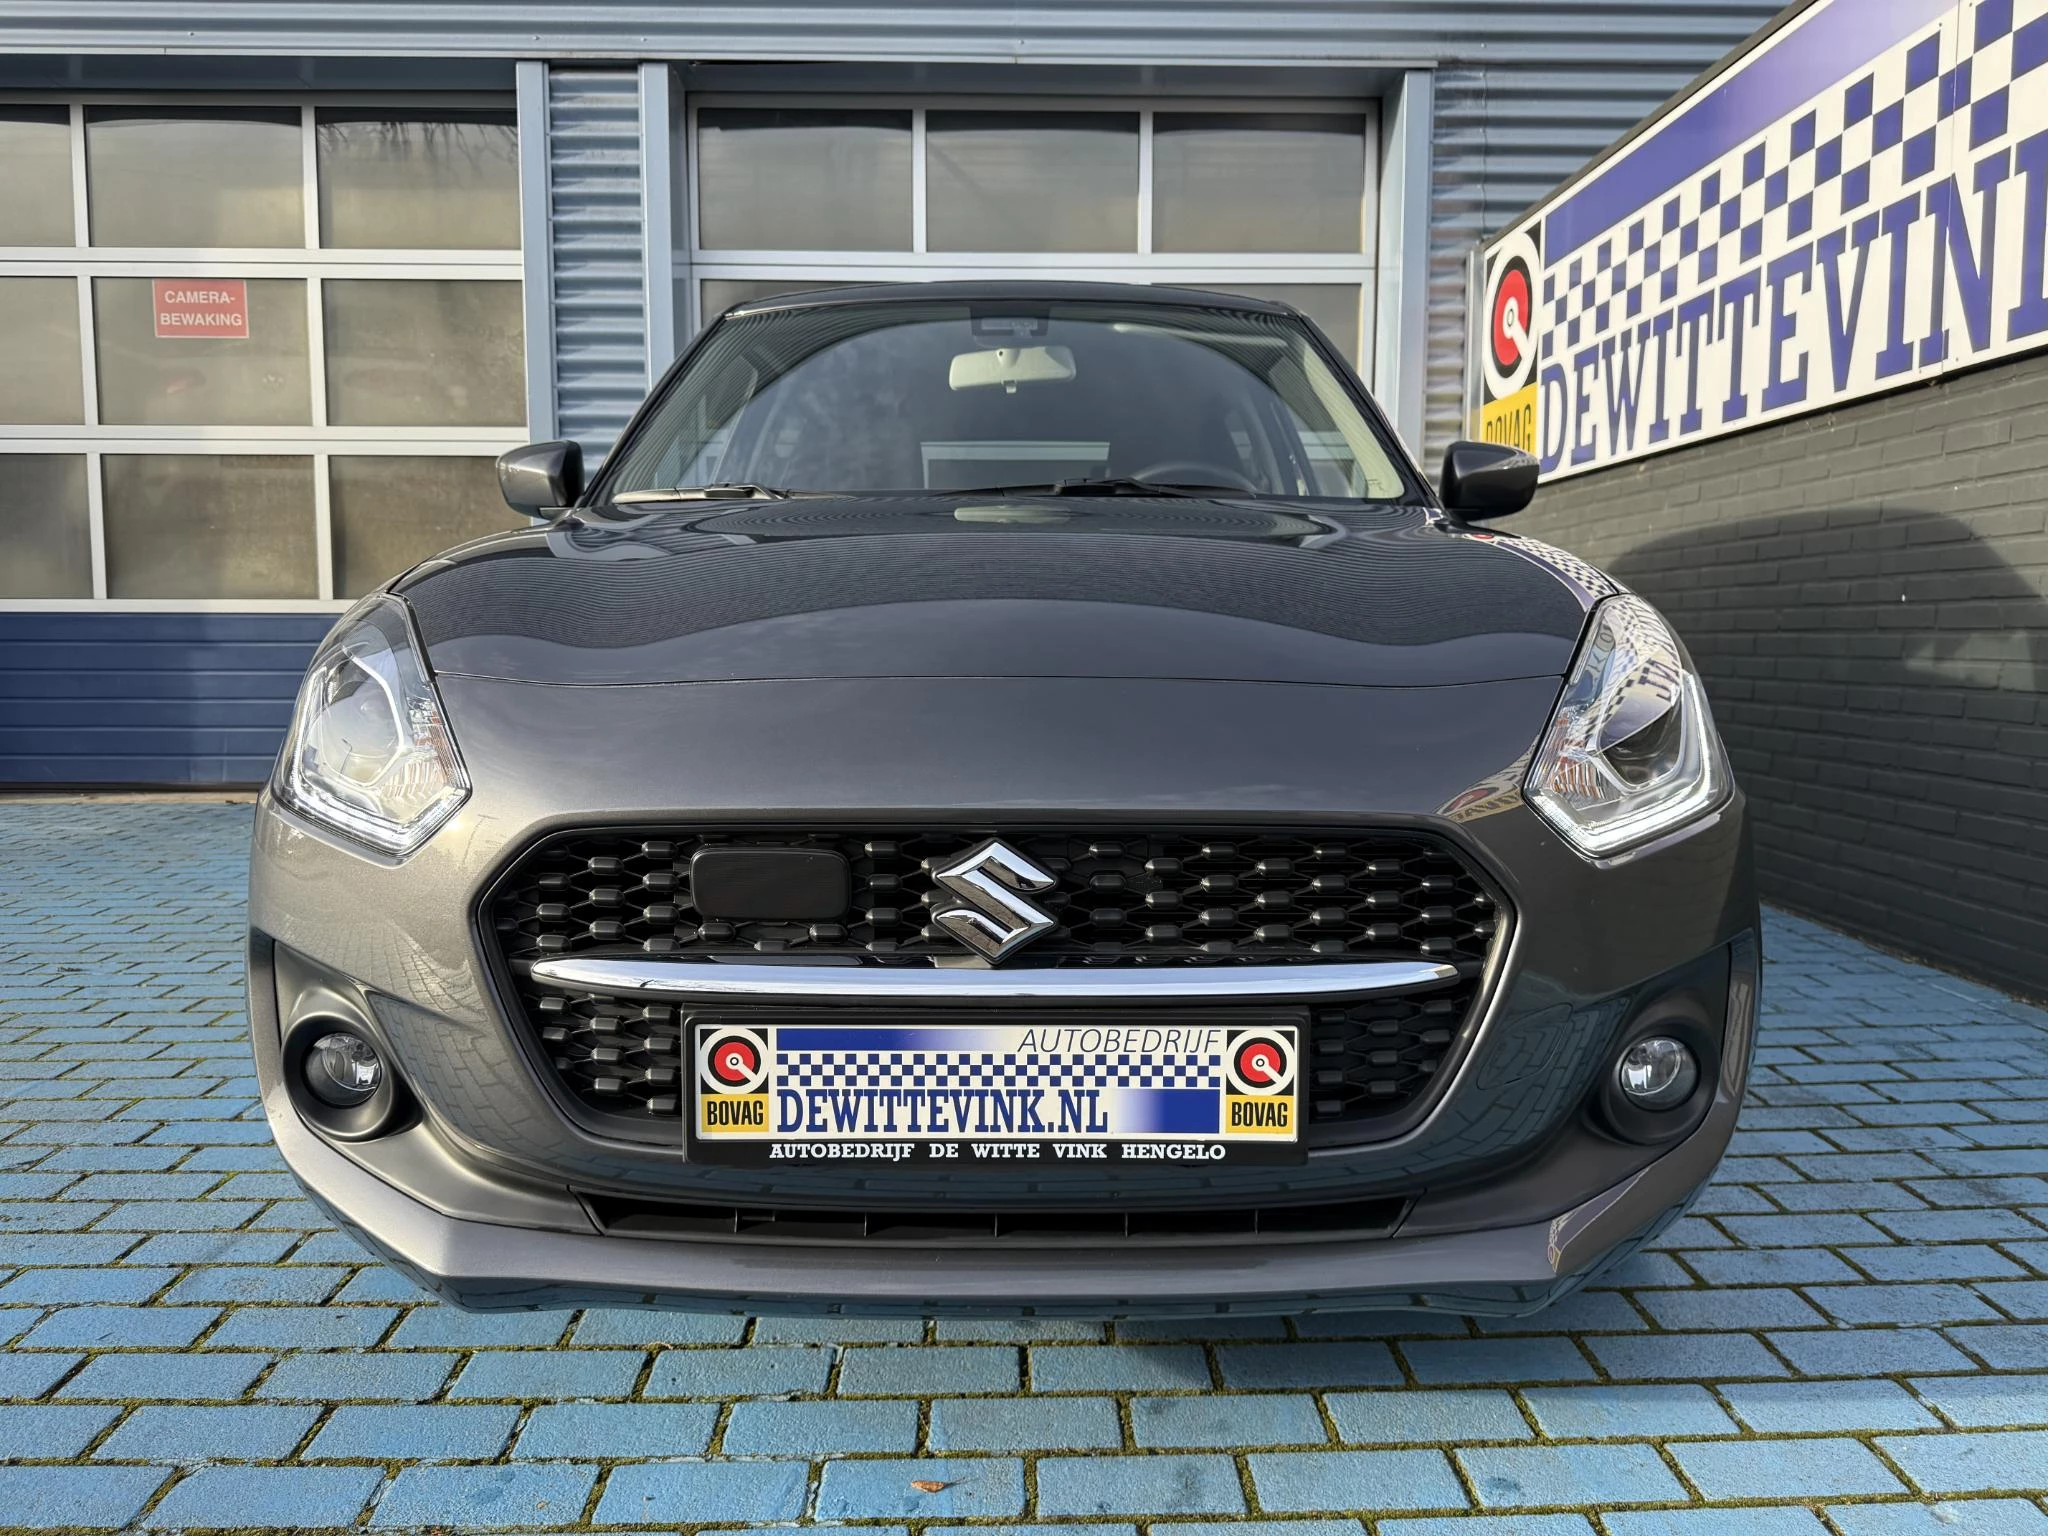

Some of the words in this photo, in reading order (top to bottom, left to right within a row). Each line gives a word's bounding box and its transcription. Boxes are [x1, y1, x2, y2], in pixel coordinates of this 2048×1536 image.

[164, 290, 236, 304] CAMERA-
[160, 312, 242, 326] BEWAKING
[1017, 1028, 1221, 1053] AUTOBEDRIJF
[706, 1099, 764, 1126] BOVAG
[777, 1088, 1109, 1134] DEWITTEVINK.NL
[1231, 1101, 1288, 1127] BOVAG
[769, 1143, 915, 1161] AUTOBEDRIJF
[929, 1143, 959, 1158] DE
[971, 1143, 1040, 1159] WITTE
[1052, 1144, 1108, 1159] VINK
[1121, 1144, 1226, 1160] HENGELO
